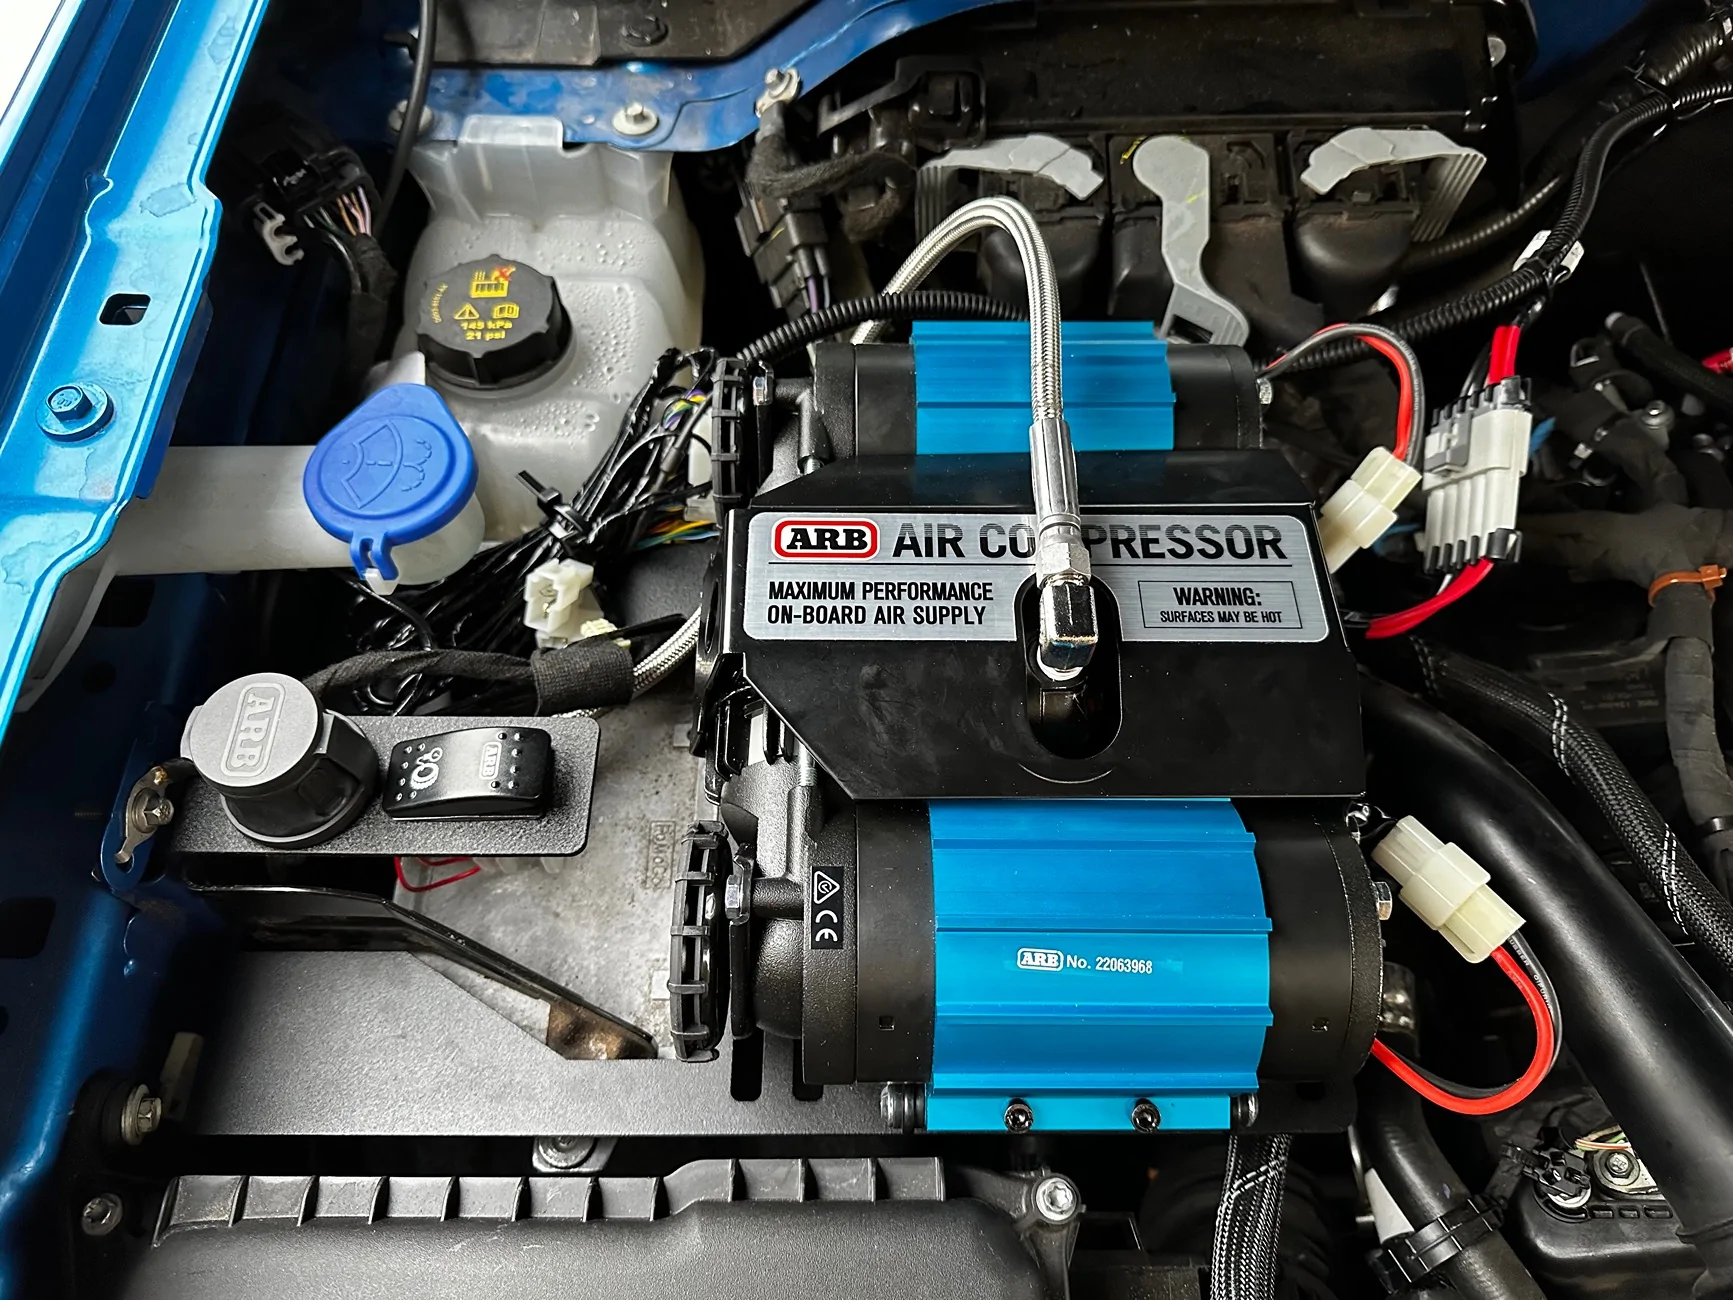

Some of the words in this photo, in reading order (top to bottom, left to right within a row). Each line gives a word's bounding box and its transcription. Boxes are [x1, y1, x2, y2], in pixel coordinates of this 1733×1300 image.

[465, 330, 482, 340] 21
[485, 330, 505, 341] psi
[487, 320, 512, 329] kPa
[786, 527, 869, 551] ARB
[892, 522, 966, 558] AIR
[979, 523, 1288, 560] COPRESSOR
[768, 581, 855, 600] MAXIMUM
[862, 582, 994, 601] PERFORMANCE
[1173, 587, 1262, 606] WARNING:
[767, 605, 867, 624] ON-BOARD
[873, 605, 906, 624] AIR
[912, 605, 987, 625] SUPPLY
[1160, 610, 1215, 623] SURFACES
[1217, 610, 1243, 623] MAY
[1244, 610, 1258, 623] BE
[1261, 611, 1283, 624] HOT
[229, 692, 276, 769] ARB
[481, 745, 499, 777] ARB
[815, 909, 838, 942] CE
[1020, 951, 1060, 968] ARB
[1066, 954, 1092, 970] No.
[1095, 956, 1153, 975] 22063968
